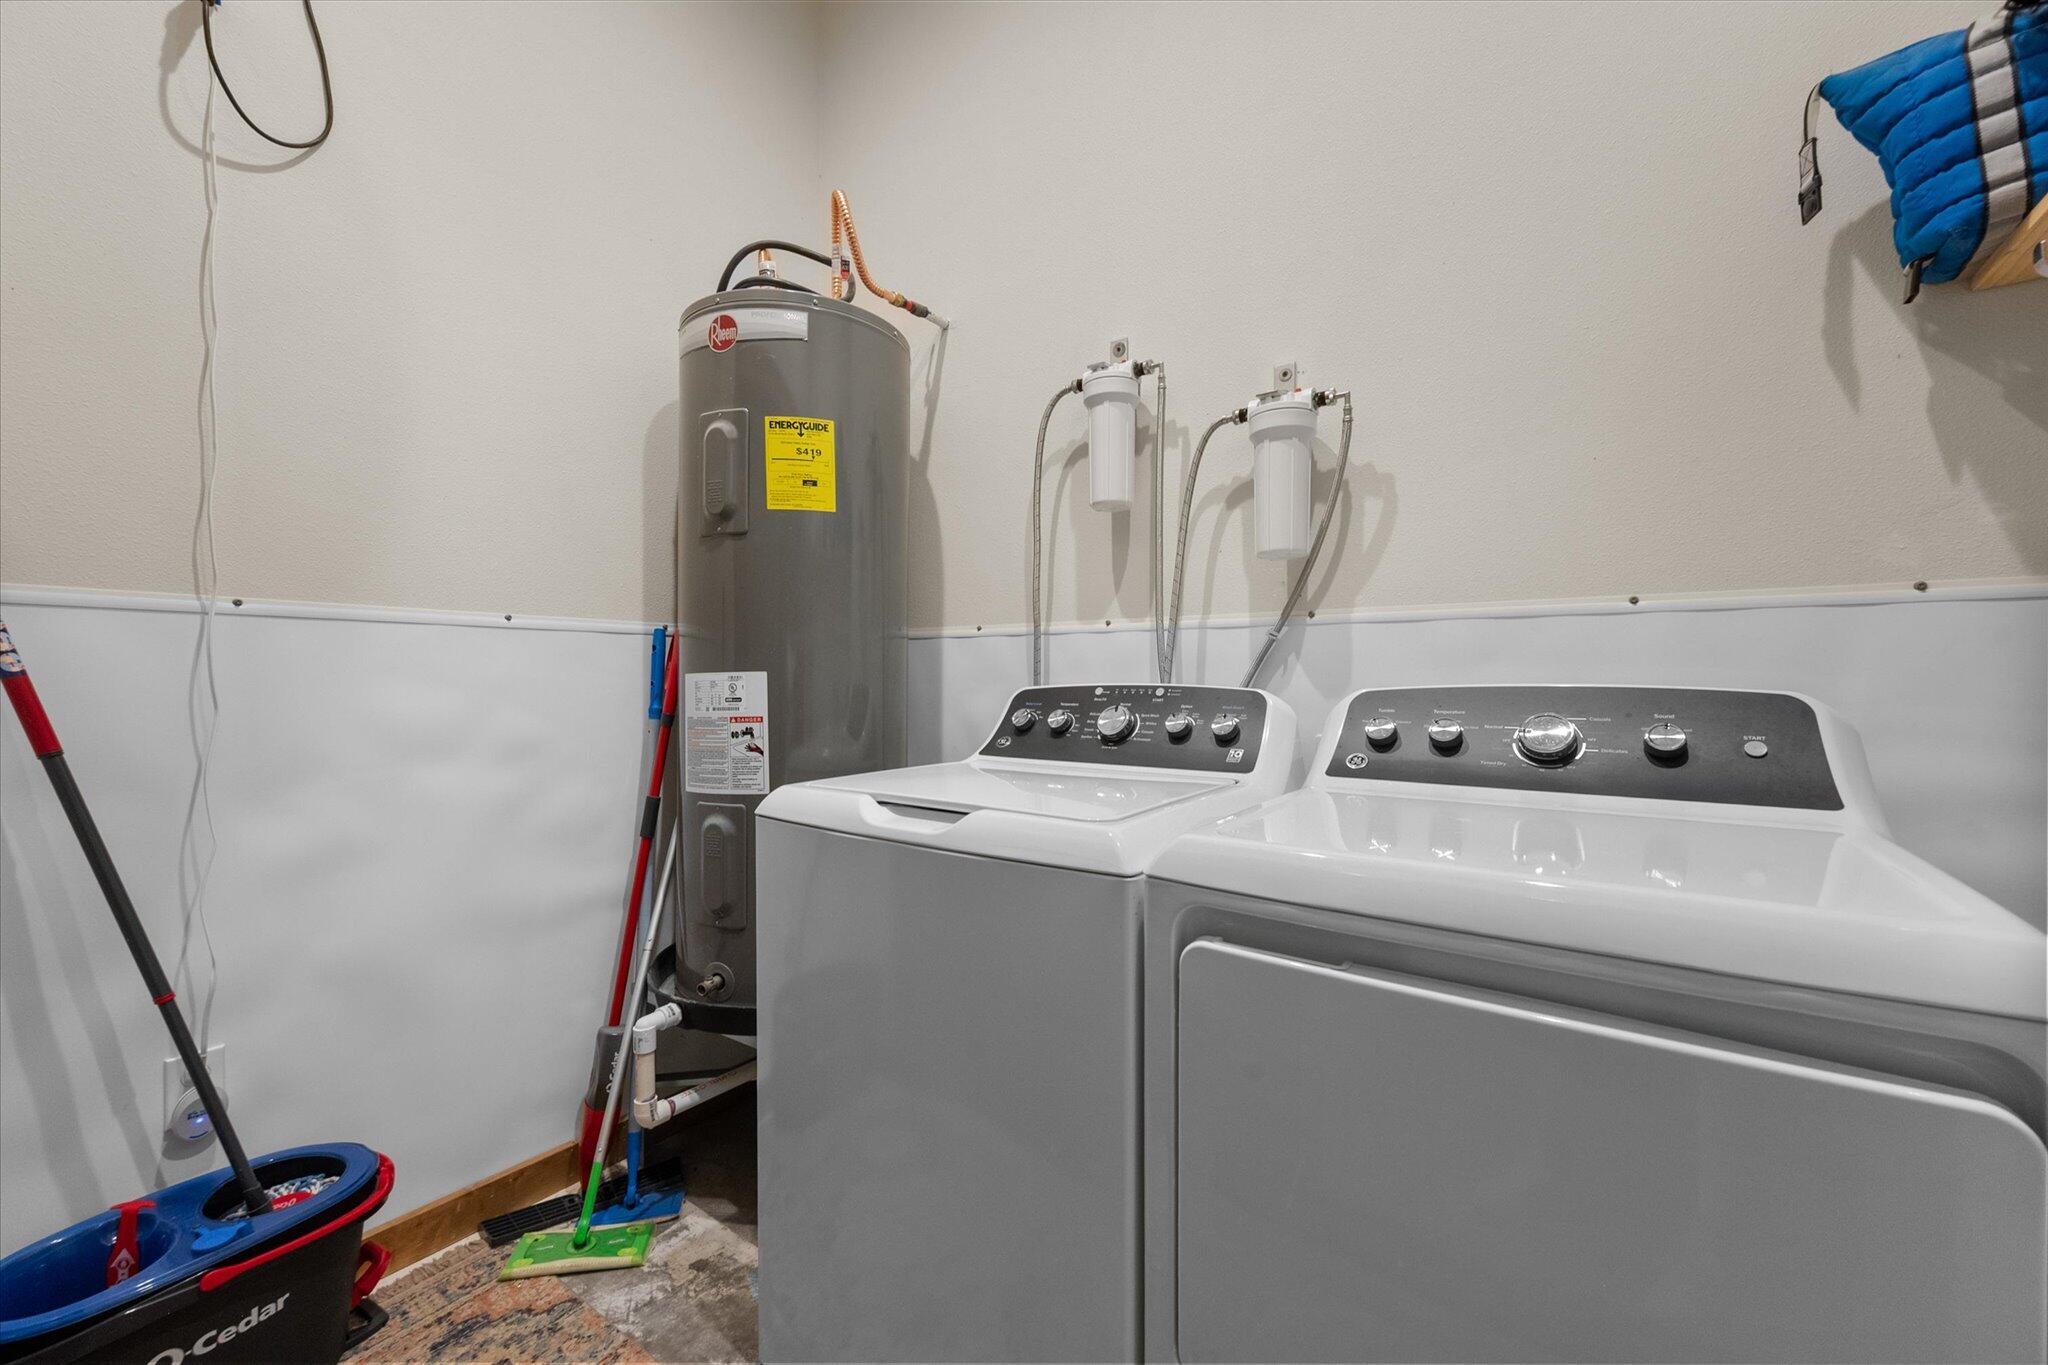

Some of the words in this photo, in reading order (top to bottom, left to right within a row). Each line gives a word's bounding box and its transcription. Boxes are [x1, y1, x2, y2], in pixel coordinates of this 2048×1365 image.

[709, 316, 737, 346] Rheem
[769, 420, 829, 434] ENERGYGUIDE
[796, 447, 822, 457] $419
